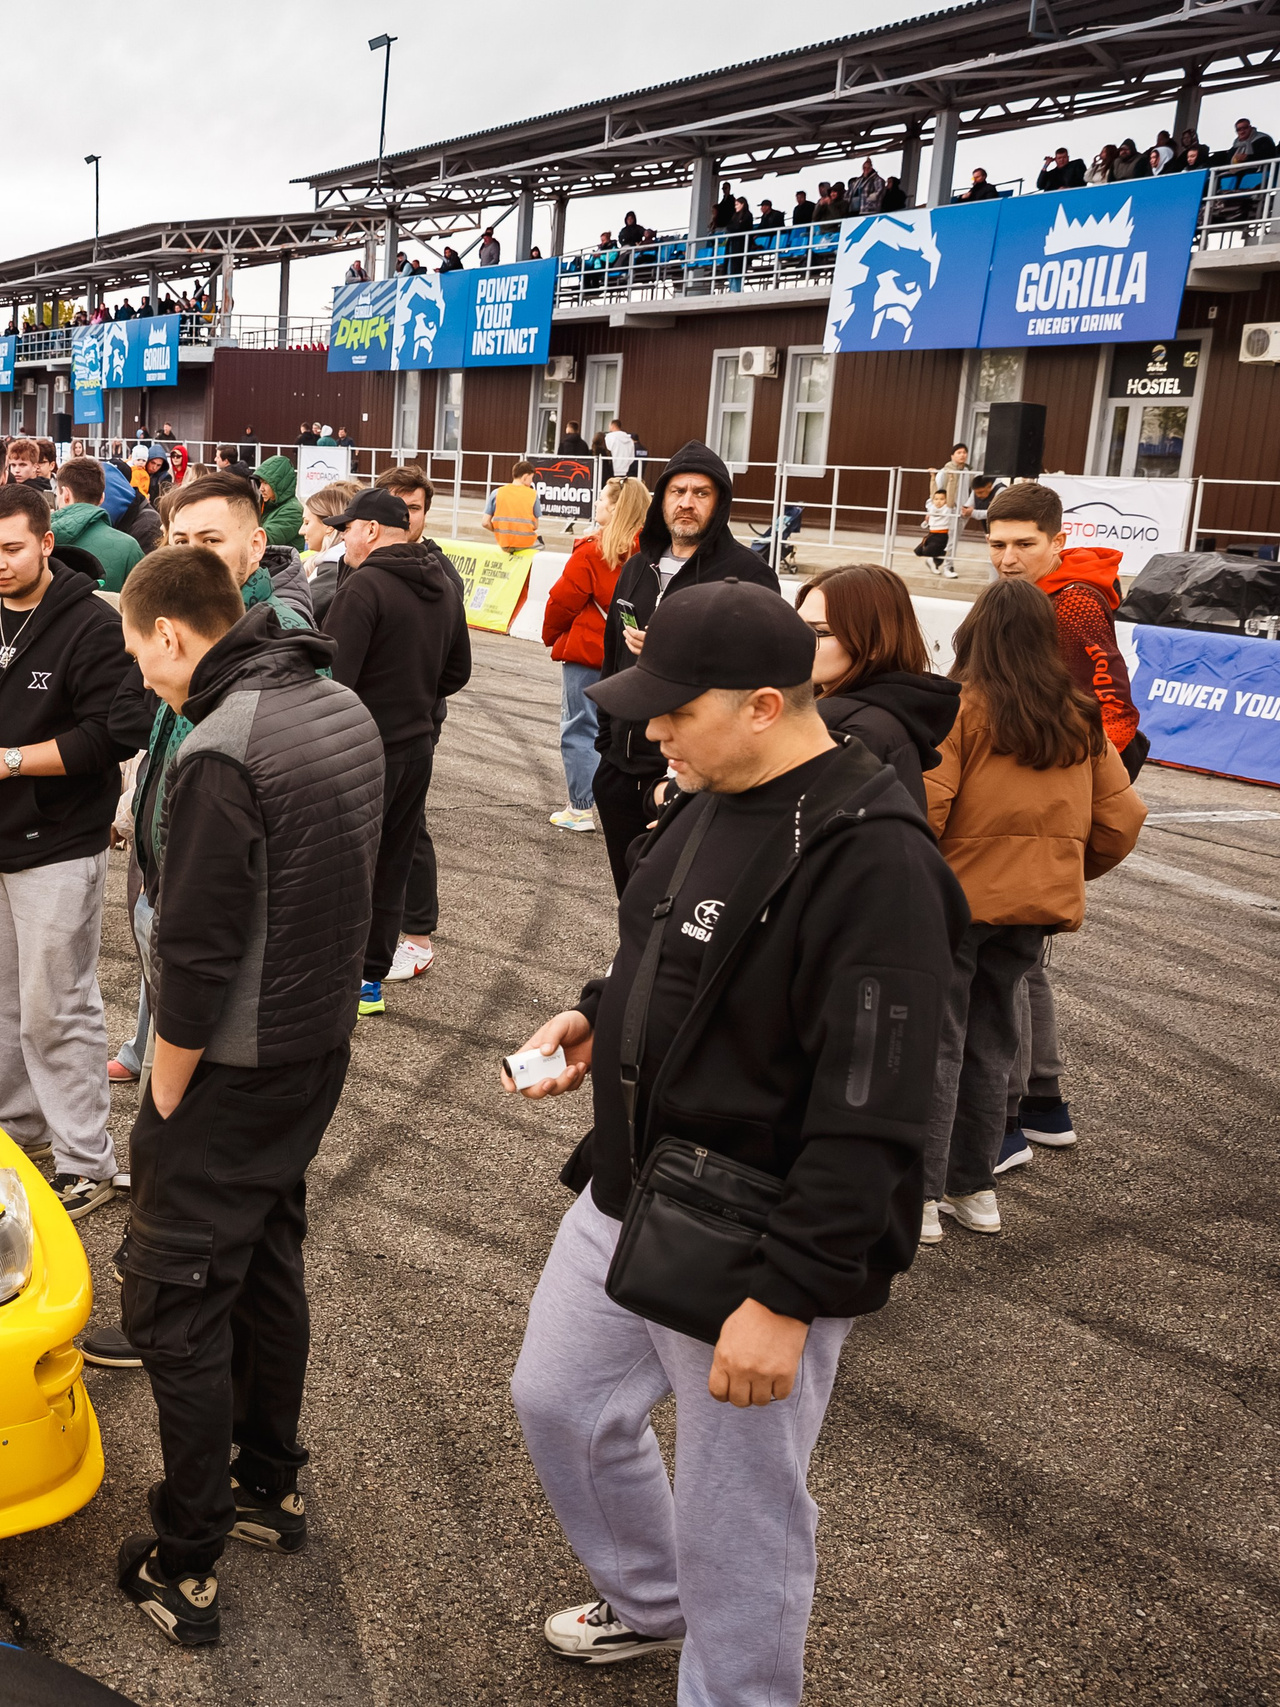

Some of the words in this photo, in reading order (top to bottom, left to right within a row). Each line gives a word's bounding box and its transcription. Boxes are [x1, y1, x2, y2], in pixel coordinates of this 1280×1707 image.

[476, 274, 529, 304] POWER
[1015, 251, 1148, 313] GORILLA
[475, 303, 513, 330] YOUR
[1026, 316, 1080, 336] ENERGY
[1080, 312, 1125, 333] DRINK
[334, 316, 390, 351] DRIFT
[472, 327, 539, 356] INSTINCT
[143, 346, 170, 371] GORILLA
[1126, 377, 1181, 395] HOSTEL
[536, 481, 591, 503] Pandora
[546, 504, 561, 513] ALARM
[561, 505, 581, 515] SYSTEM
[1147, 677, 1229, 712] POWER
[1233, 690, 1280, 722] YOU
[194, 1595, 209, 1603] AIR
